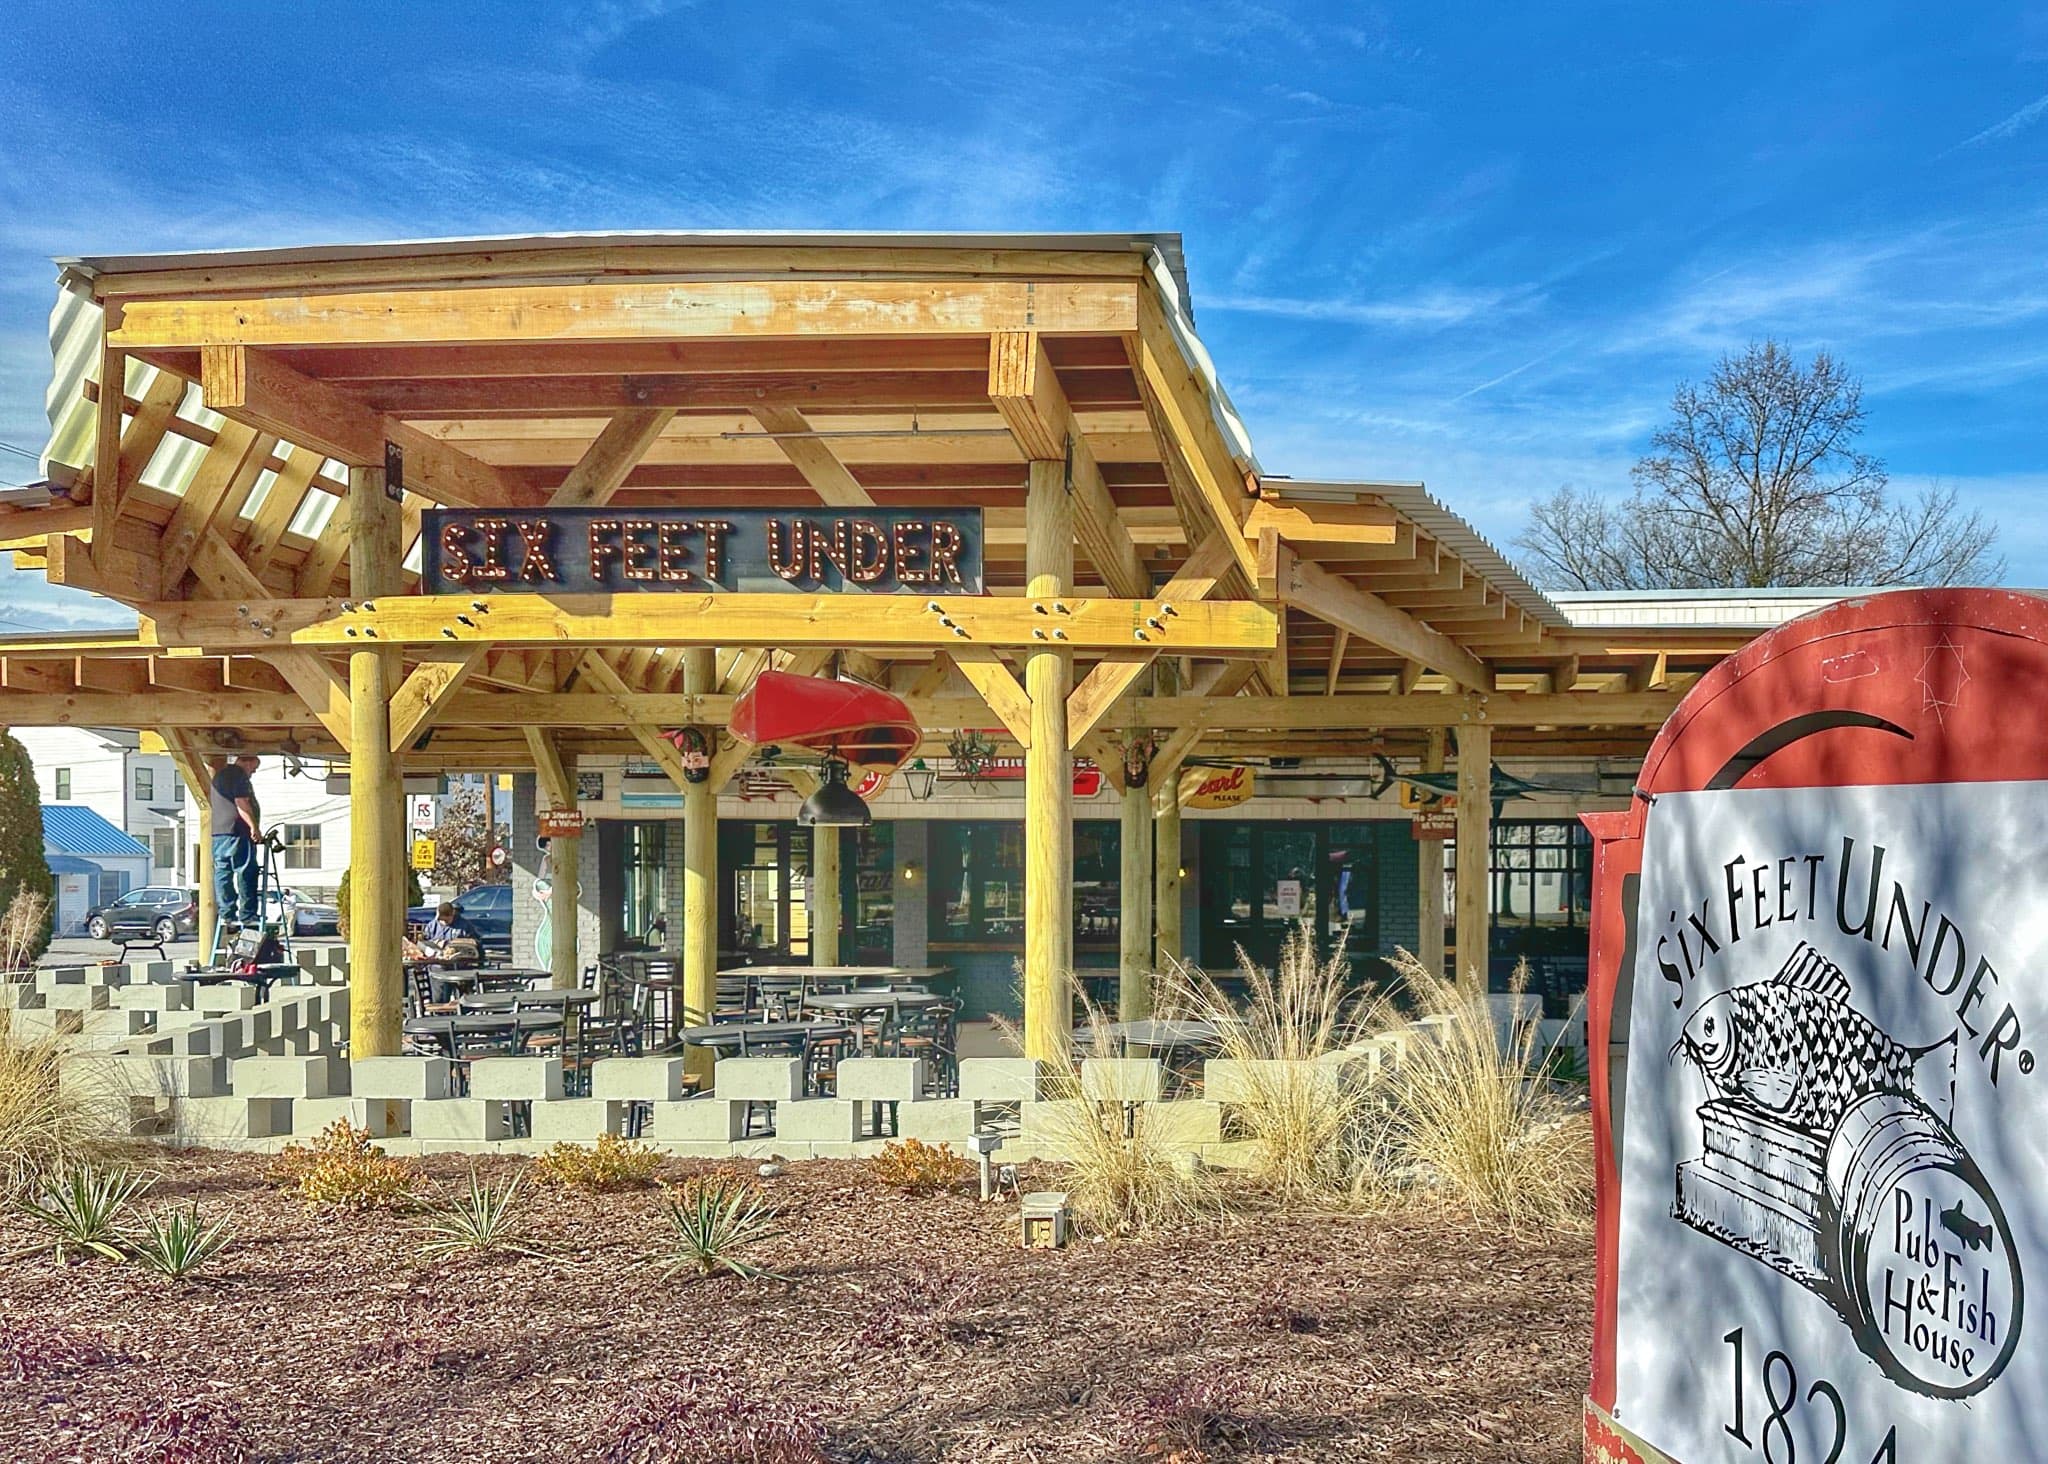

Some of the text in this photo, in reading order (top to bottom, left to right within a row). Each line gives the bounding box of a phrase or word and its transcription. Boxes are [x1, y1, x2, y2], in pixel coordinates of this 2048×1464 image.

[440, 519, 963, 584] SIX FEET UNDER
[1724, 854, 1825, 944] FEET
[1894, 1186, 1940, 1270] Pub
[1883, 1266, 1976, 1378] House
[1917, 1250, 1996, 1346] & Fish
